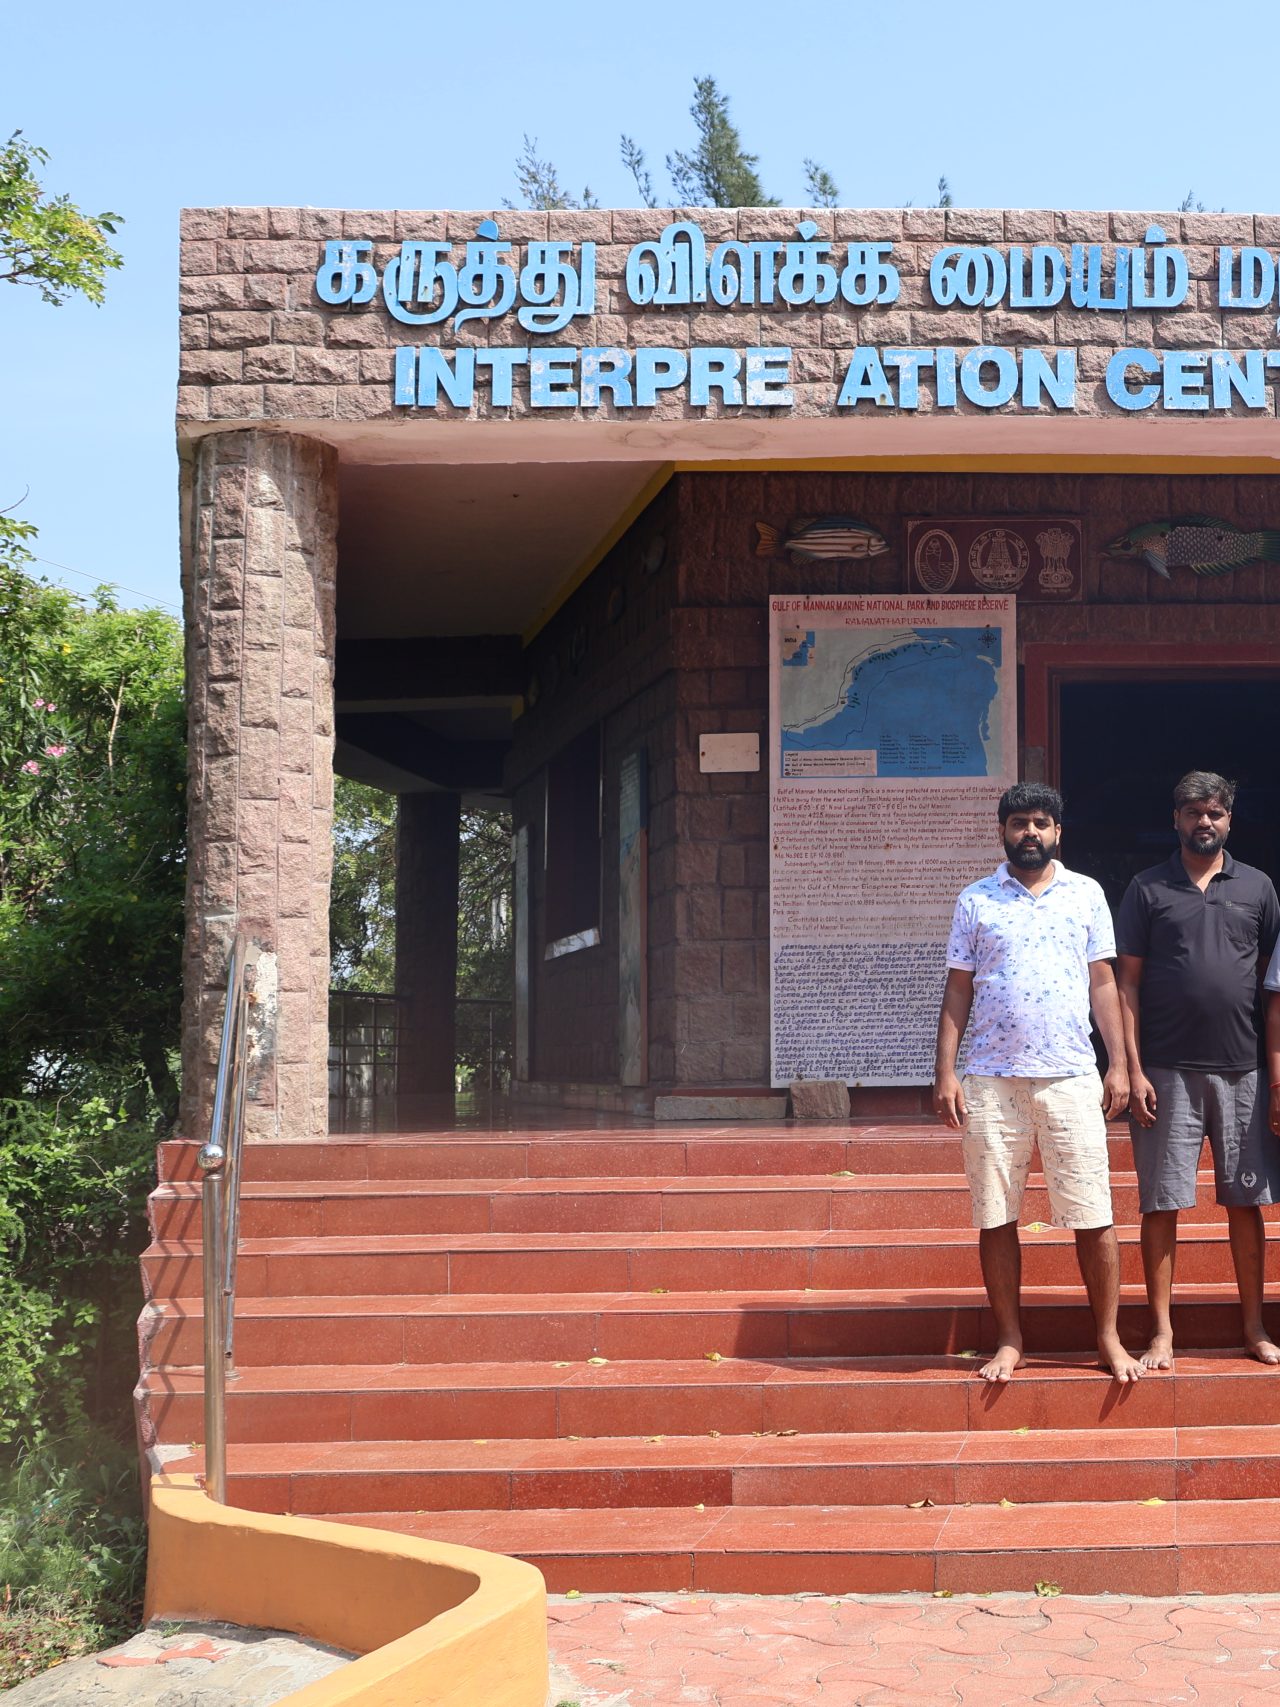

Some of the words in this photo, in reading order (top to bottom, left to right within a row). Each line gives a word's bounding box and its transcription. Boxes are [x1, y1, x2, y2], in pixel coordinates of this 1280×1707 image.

[316, 219, 596, 334] கருத்து
[625, 219, 901, 308] விளக்க
[929, 223, 1188, 311] மையம்
[772, 601, 790, 612] GULF
[792, 601, 802, 612] OF
[803, 601, 835, 612] MANNAR
[836, 601, 865, 612] MARINE
[866, 600, 904, 611] NATIONAL
[907, 600, 925, 611] PARK
[926, 600, 940, 611] AND
[941, 600, 976, 611] BIOSPHERE
[977, 599, 1009, 611] RESERVE
